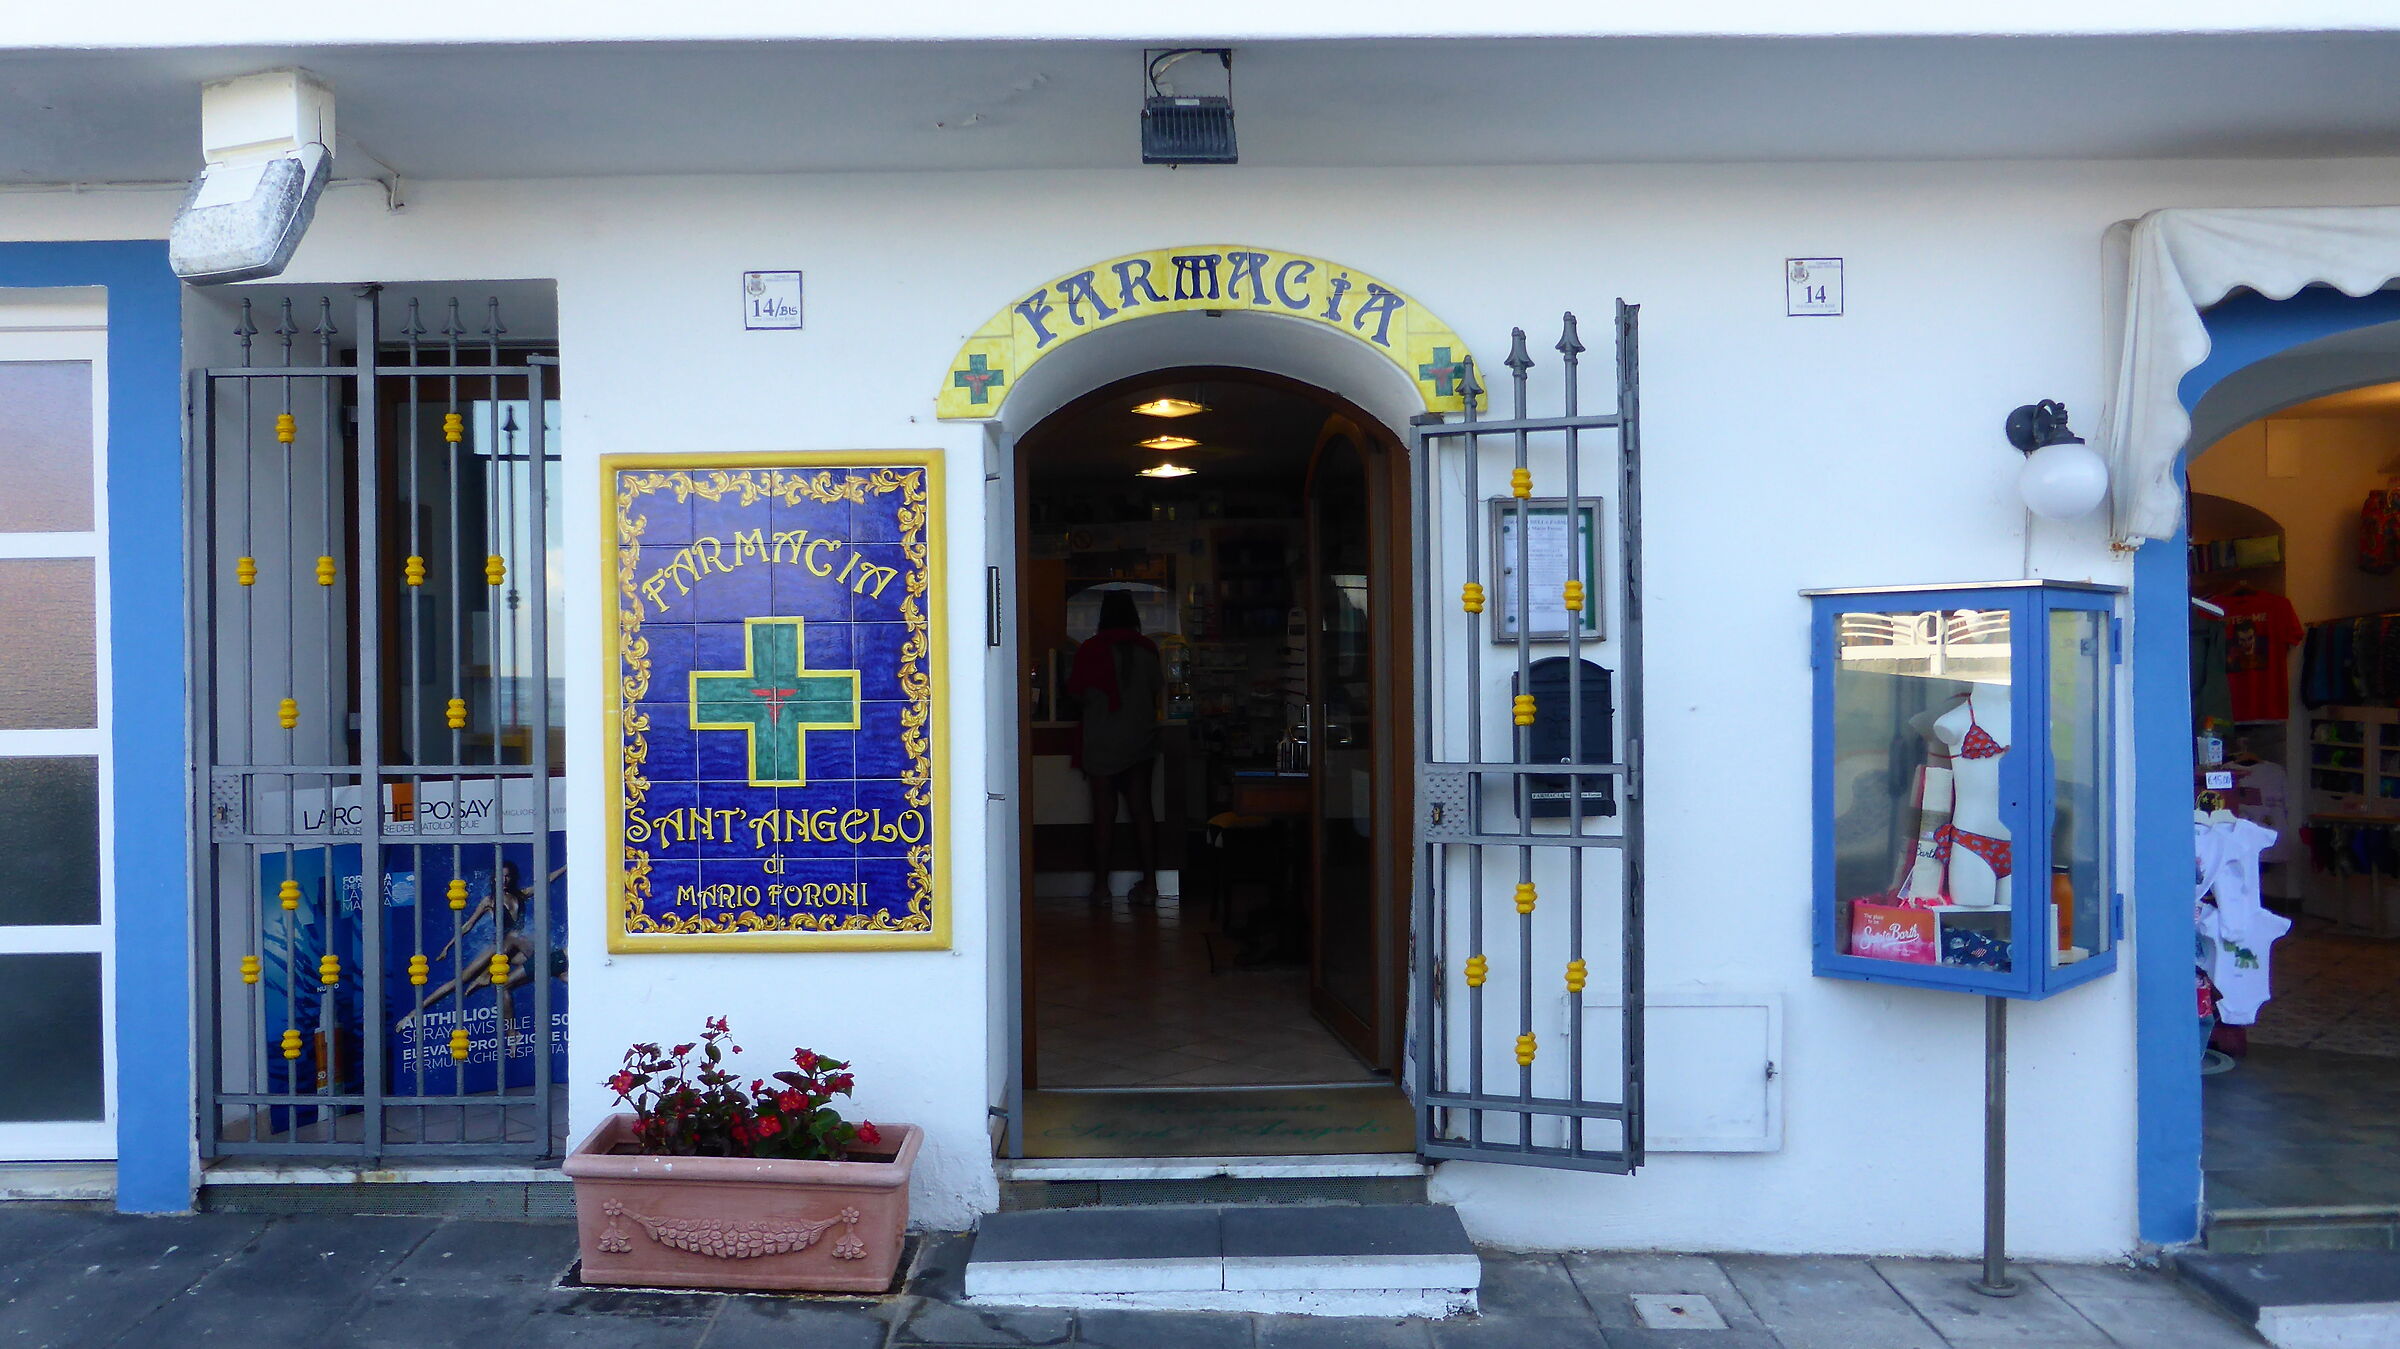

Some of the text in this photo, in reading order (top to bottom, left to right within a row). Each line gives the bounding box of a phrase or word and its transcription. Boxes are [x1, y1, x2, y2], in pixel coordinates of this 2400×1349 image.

[1805, 285, 1827, 304] 14
[641, 527, 901, 614] FARMACIA
[333, 803, 413, 827] ROHE
[625, 806, 926, 849] SANT'ANGELO
[763, 852, 786, 875] di
[343, 873, 392, 885] FORA
[676, 882, 870, 909] MARIO FORONI
[317, 983, 340, 993] NUO
[402, 1006, 499, 1030] ATHLIOS
[403, 1025, 455, 1044] SRAY
[462, 1016, 531, 1037] NVISBILE
[468, 1031, 561, 1053] PROEZIOE
[403, 1056, 472, 1074] FORMUA
[503, 1043, 566, 1060] RISPTA
